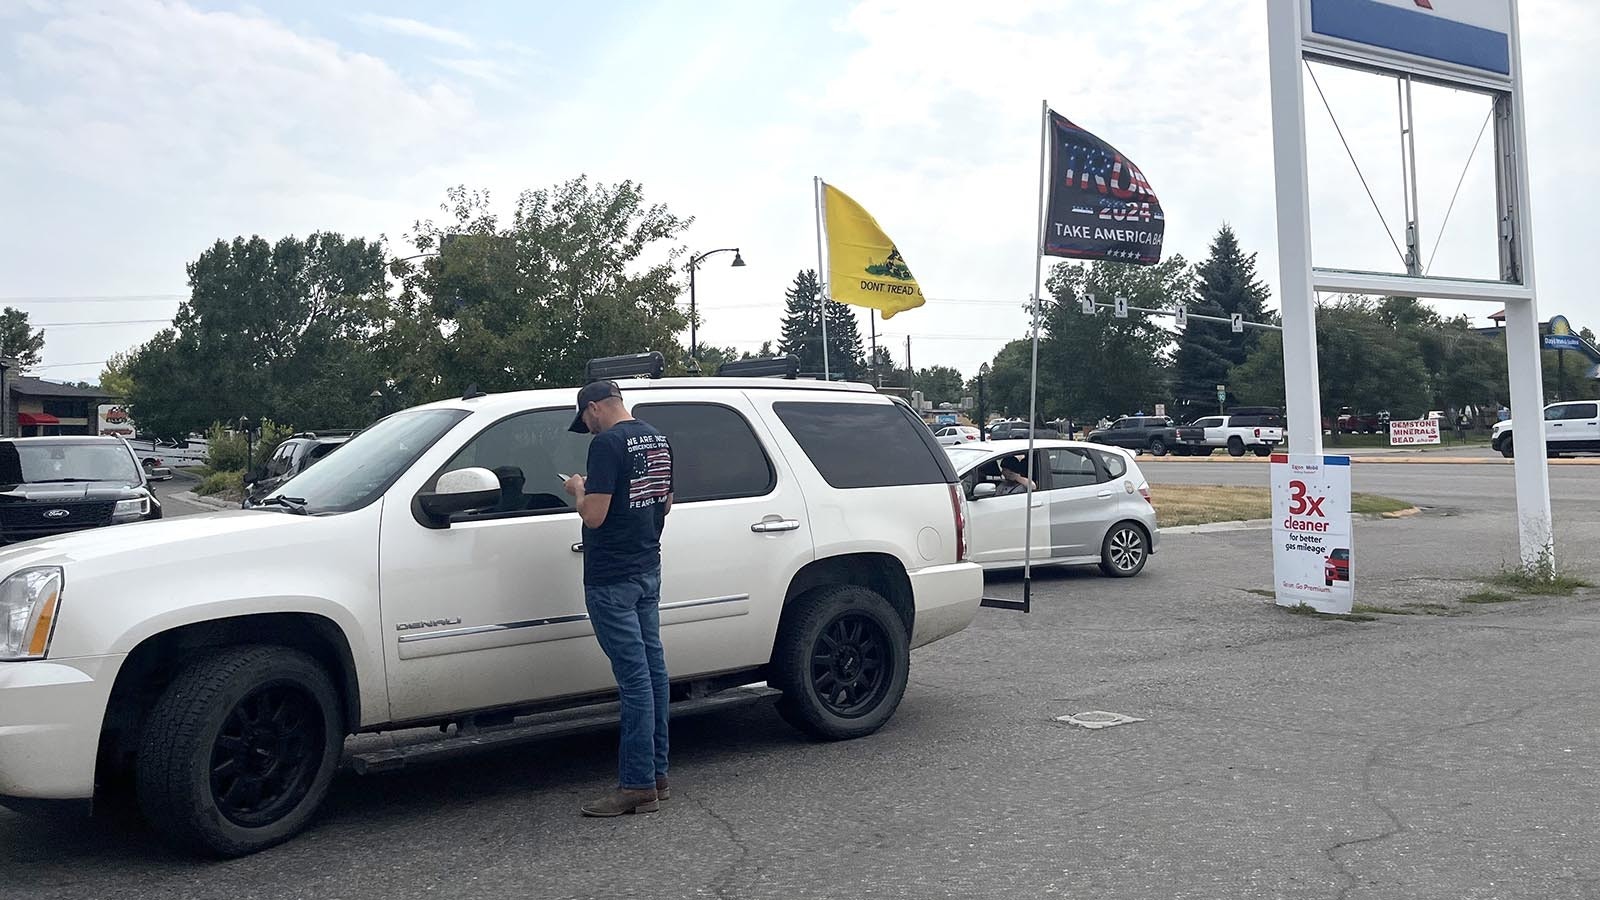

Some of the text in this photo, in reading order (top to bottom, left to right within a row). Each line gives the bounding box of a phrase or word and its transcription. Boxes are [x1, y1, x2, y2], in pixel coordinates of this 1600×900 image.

[1099, 198, 1151, 222] 2024
[1055, 222, 1091, 239] TAKE
[1095, 227, 1152, 245] AMERICA
[860, 281, 885, 292] DONT
[887, 284, 914, 295] TREAD
[1393, 428, 1436, 436] MINERALS
[627, 437, 638, 446] WE
[639, 435, 654, 443] ARE
[1289, 480, 1325, 517] 3x
[1284, 516, 1329, 532] cleaner
[1289, 532, 1322, 543] for better
